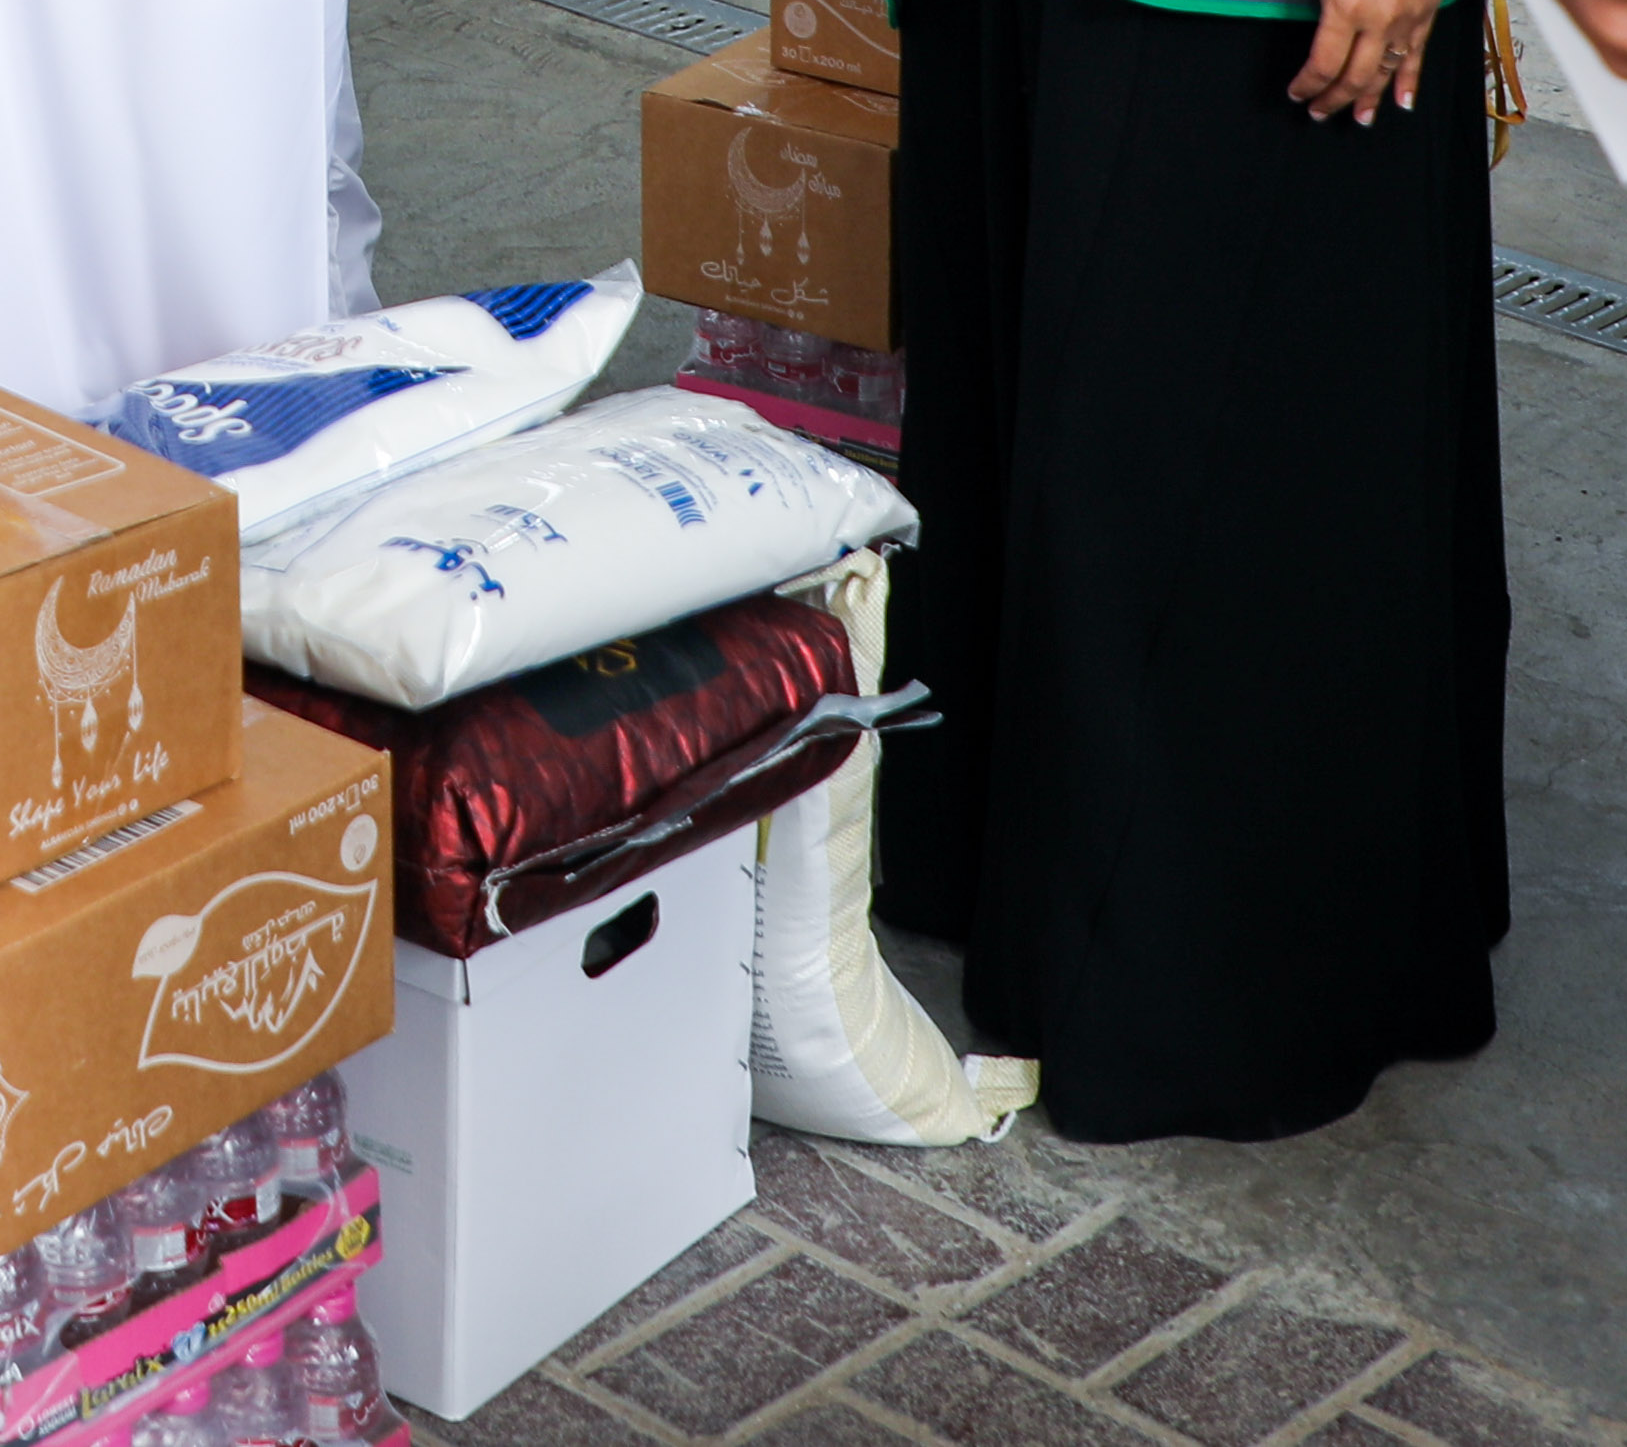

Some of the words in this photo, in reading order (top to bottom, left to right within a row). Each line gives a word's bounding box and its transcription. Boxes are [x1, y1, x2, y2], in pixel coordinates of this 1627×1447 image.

[781, 45, 798, 59] 30
[87, 549, 178, 598] Ramadan
[135, 556, 211, 603] Mubarak
[9, 793, 65, 837] Shape
[72, 775, 122, 804] Your
[133, 741, 170, 782] Life
[360, 774, 379, 795] 30
[307, 793, 346, 823] x200
